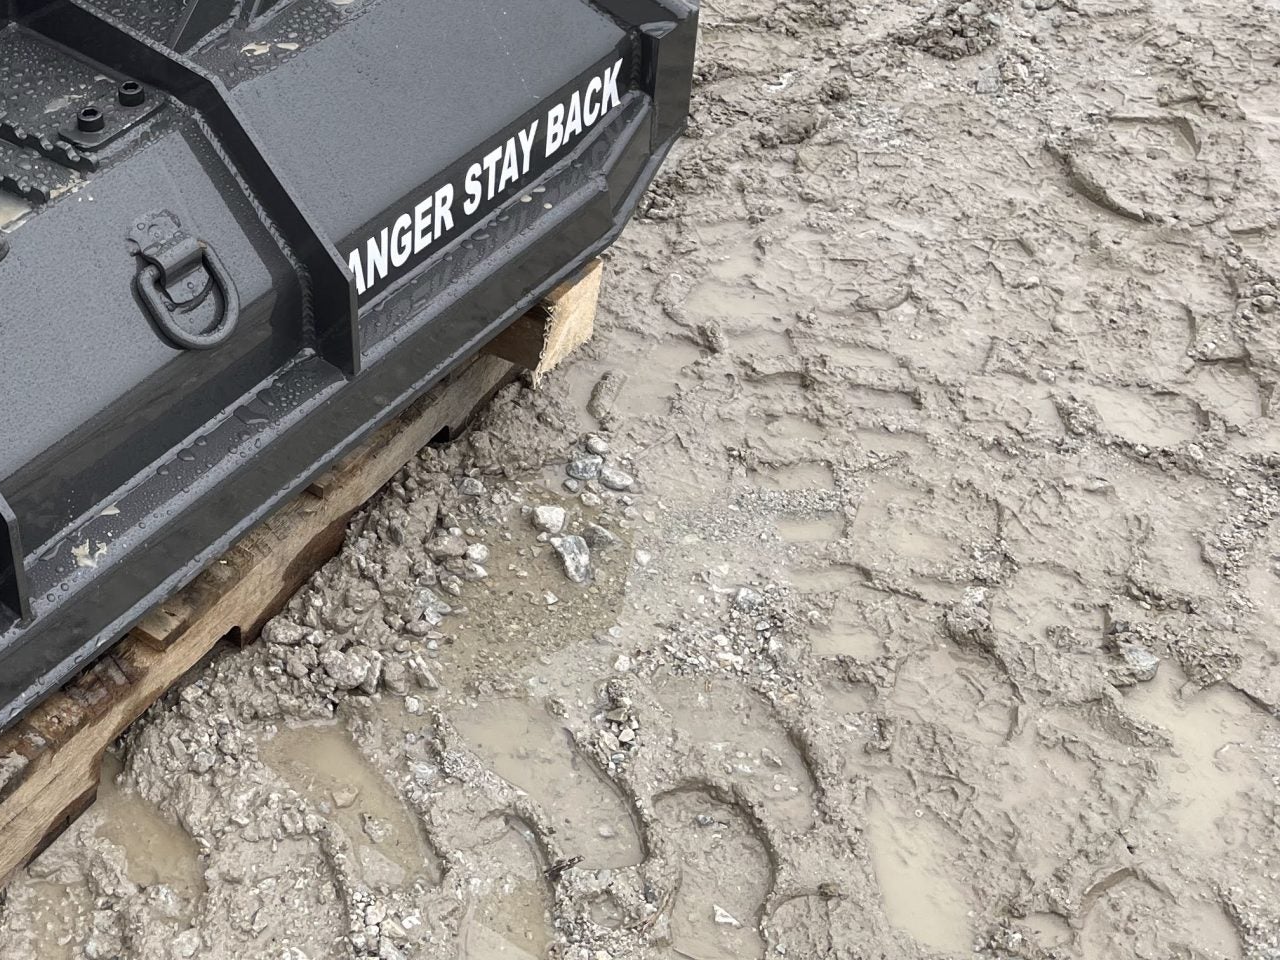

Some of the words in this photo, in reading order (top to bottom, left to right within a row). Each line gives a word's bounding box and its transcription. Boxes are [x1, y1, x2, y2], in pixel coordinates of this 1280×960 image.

[348, 183, 454, 296] ANGER
[463, 119, 539, 216] STAY
[545, 58, 624, 158] BACK
